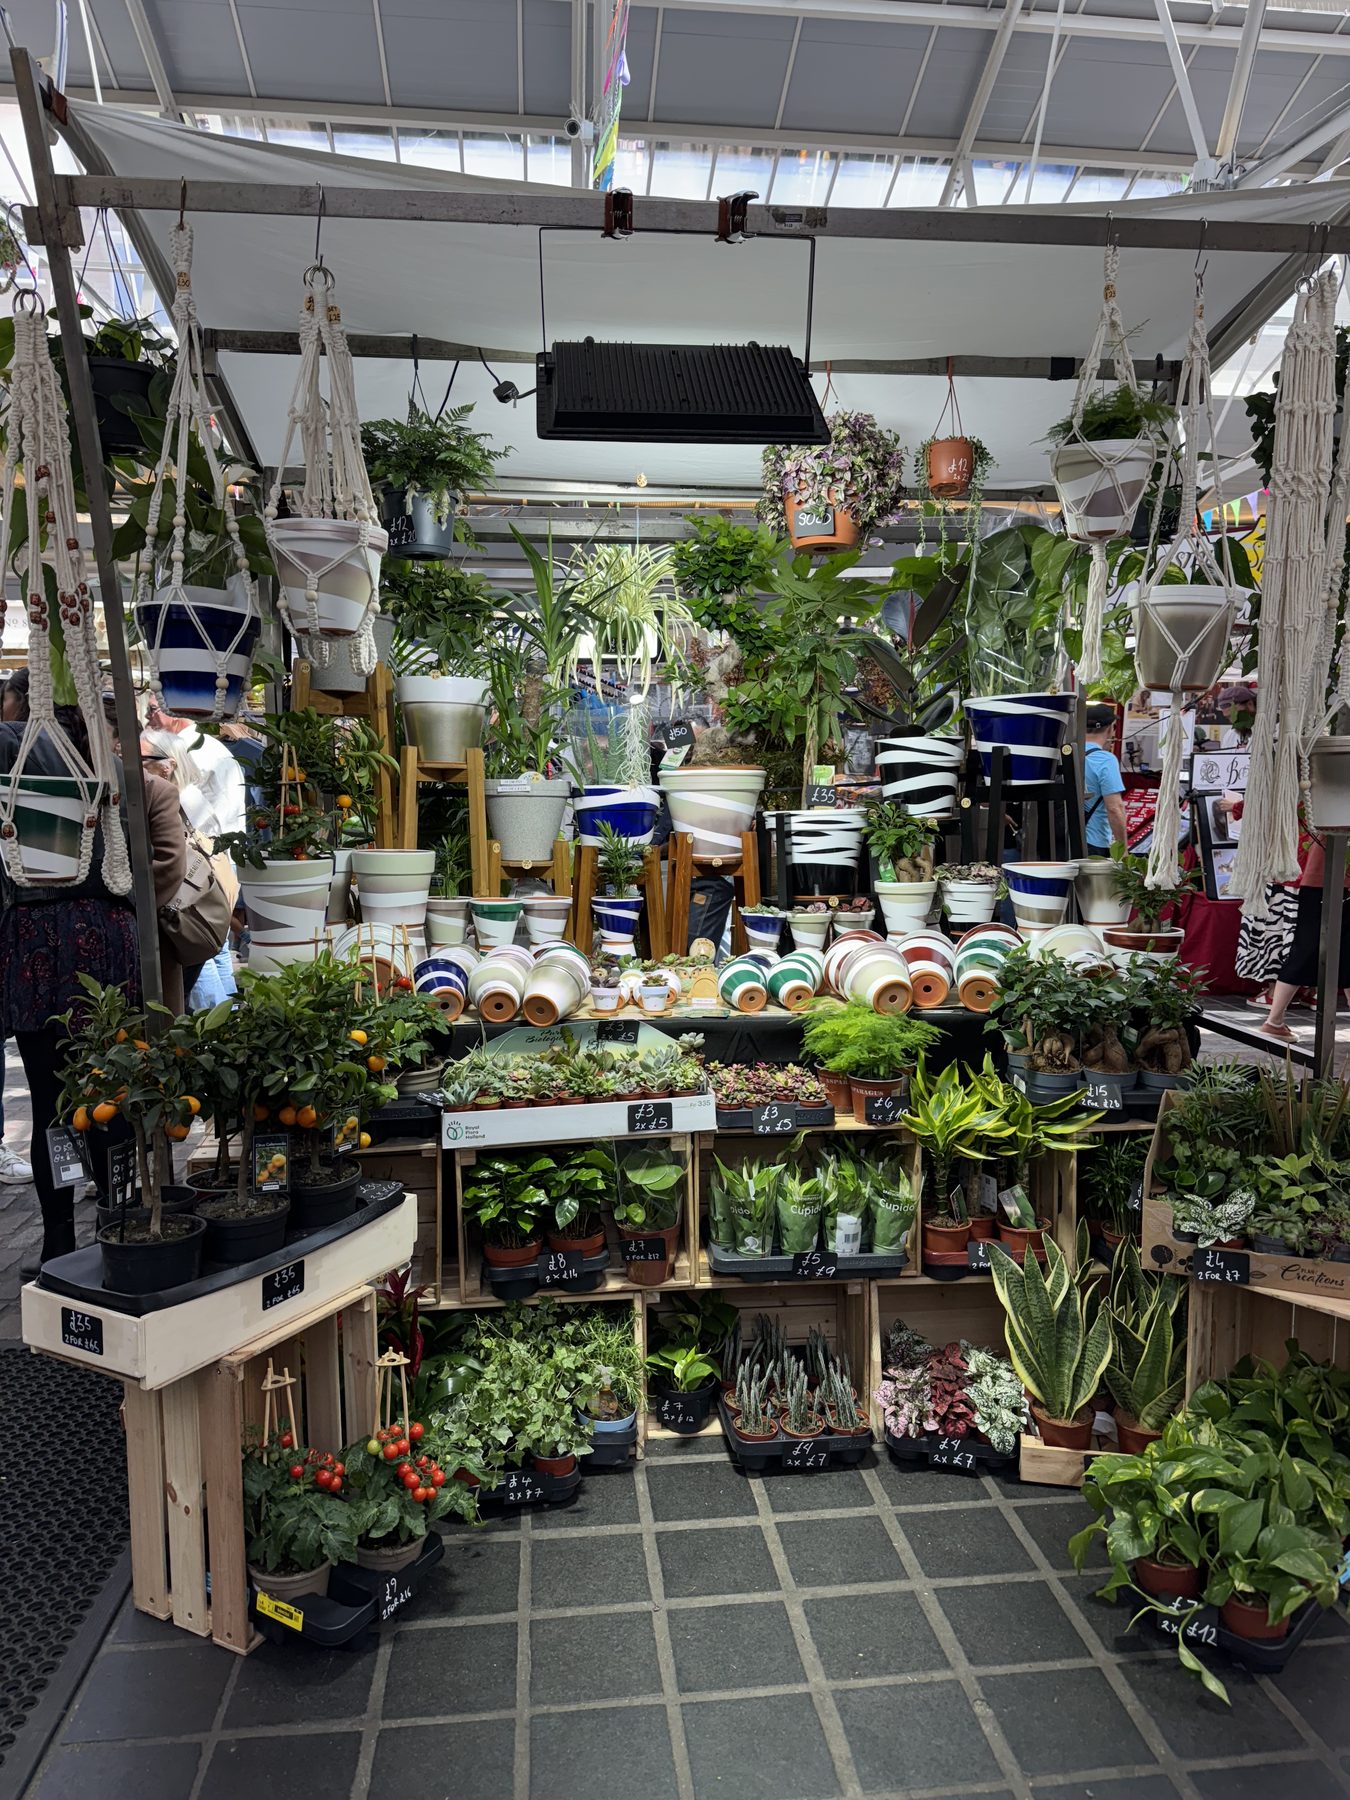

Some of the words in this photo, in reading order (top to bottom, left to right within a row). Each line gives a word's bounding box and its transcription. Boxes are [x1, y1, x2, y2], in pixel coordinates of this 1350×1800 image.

[948, 457, 968, 473] £12
[390, 515, 409, 533] £12
[669, 727, 688, 741] £150
[811, 787, 835, 804] £35
[605, 1020, 625, 1032] £3
[618, 1031, 635, 1042] £5
[1086, 1083, 1108, 1098] £15
[698, 1099, 711, 1107] 335
[874, 1096, 893, 1109] £6
[1081, 1097, 1087, 1106] 2
[1102, 1098, 1121, 1109] £28
[632, 1103, 655, 1120] £3
[760, 1105, 779, 1121] £3
[648, 1117, 669, 1130] £5
[774, 1118, 793, 1132] £5
[880, 1198, 915, 1213] Cupido
[628, 1240, 646, 1252] £7
[548, 1253, 567, 1271] £8
[802, 1252, 821, 1267] £5
[971, 1262, 978, 1270] 2
[1205, 1250, 1225, 1269] £4
[273, 1265, 296, 1288] £35
[562, 1268, 578, 1280] £14
[815, 1265, 836, 1278] £9
[1197, 1271, 1204, 1281] 2
[1205, 1270, 1223, 1281] FOR
[1225, 1269, 1241, 1282] £7
[1280, 1263, 1344, 1287] Creations
[287, 1284, 301, 1298] £65
[69, 1310, 92, 1333] £35
[64, 1333, 70, 1344] 2
[69, 1335, 84, 1347] FOR
[84, 1337, 100, 1354] £65
[661, 1399, 684, 1412] £7
[791, 1441, 814, 1456] £4
[939, 1437, 961, 1451] £4
[805, 1452, 827, 1467] £7
[952, 1452, 974, 1469] £7
[508, 1474, 533, 1489] £4
[385, 1577, 397, 1602] £9
[382, 1608, 388, 1620] 2
[387, 1596, 400, 1616] FOR
[400, 1585, 412, 1604] £16
[1186, 1620, 1218, 1647] £12
